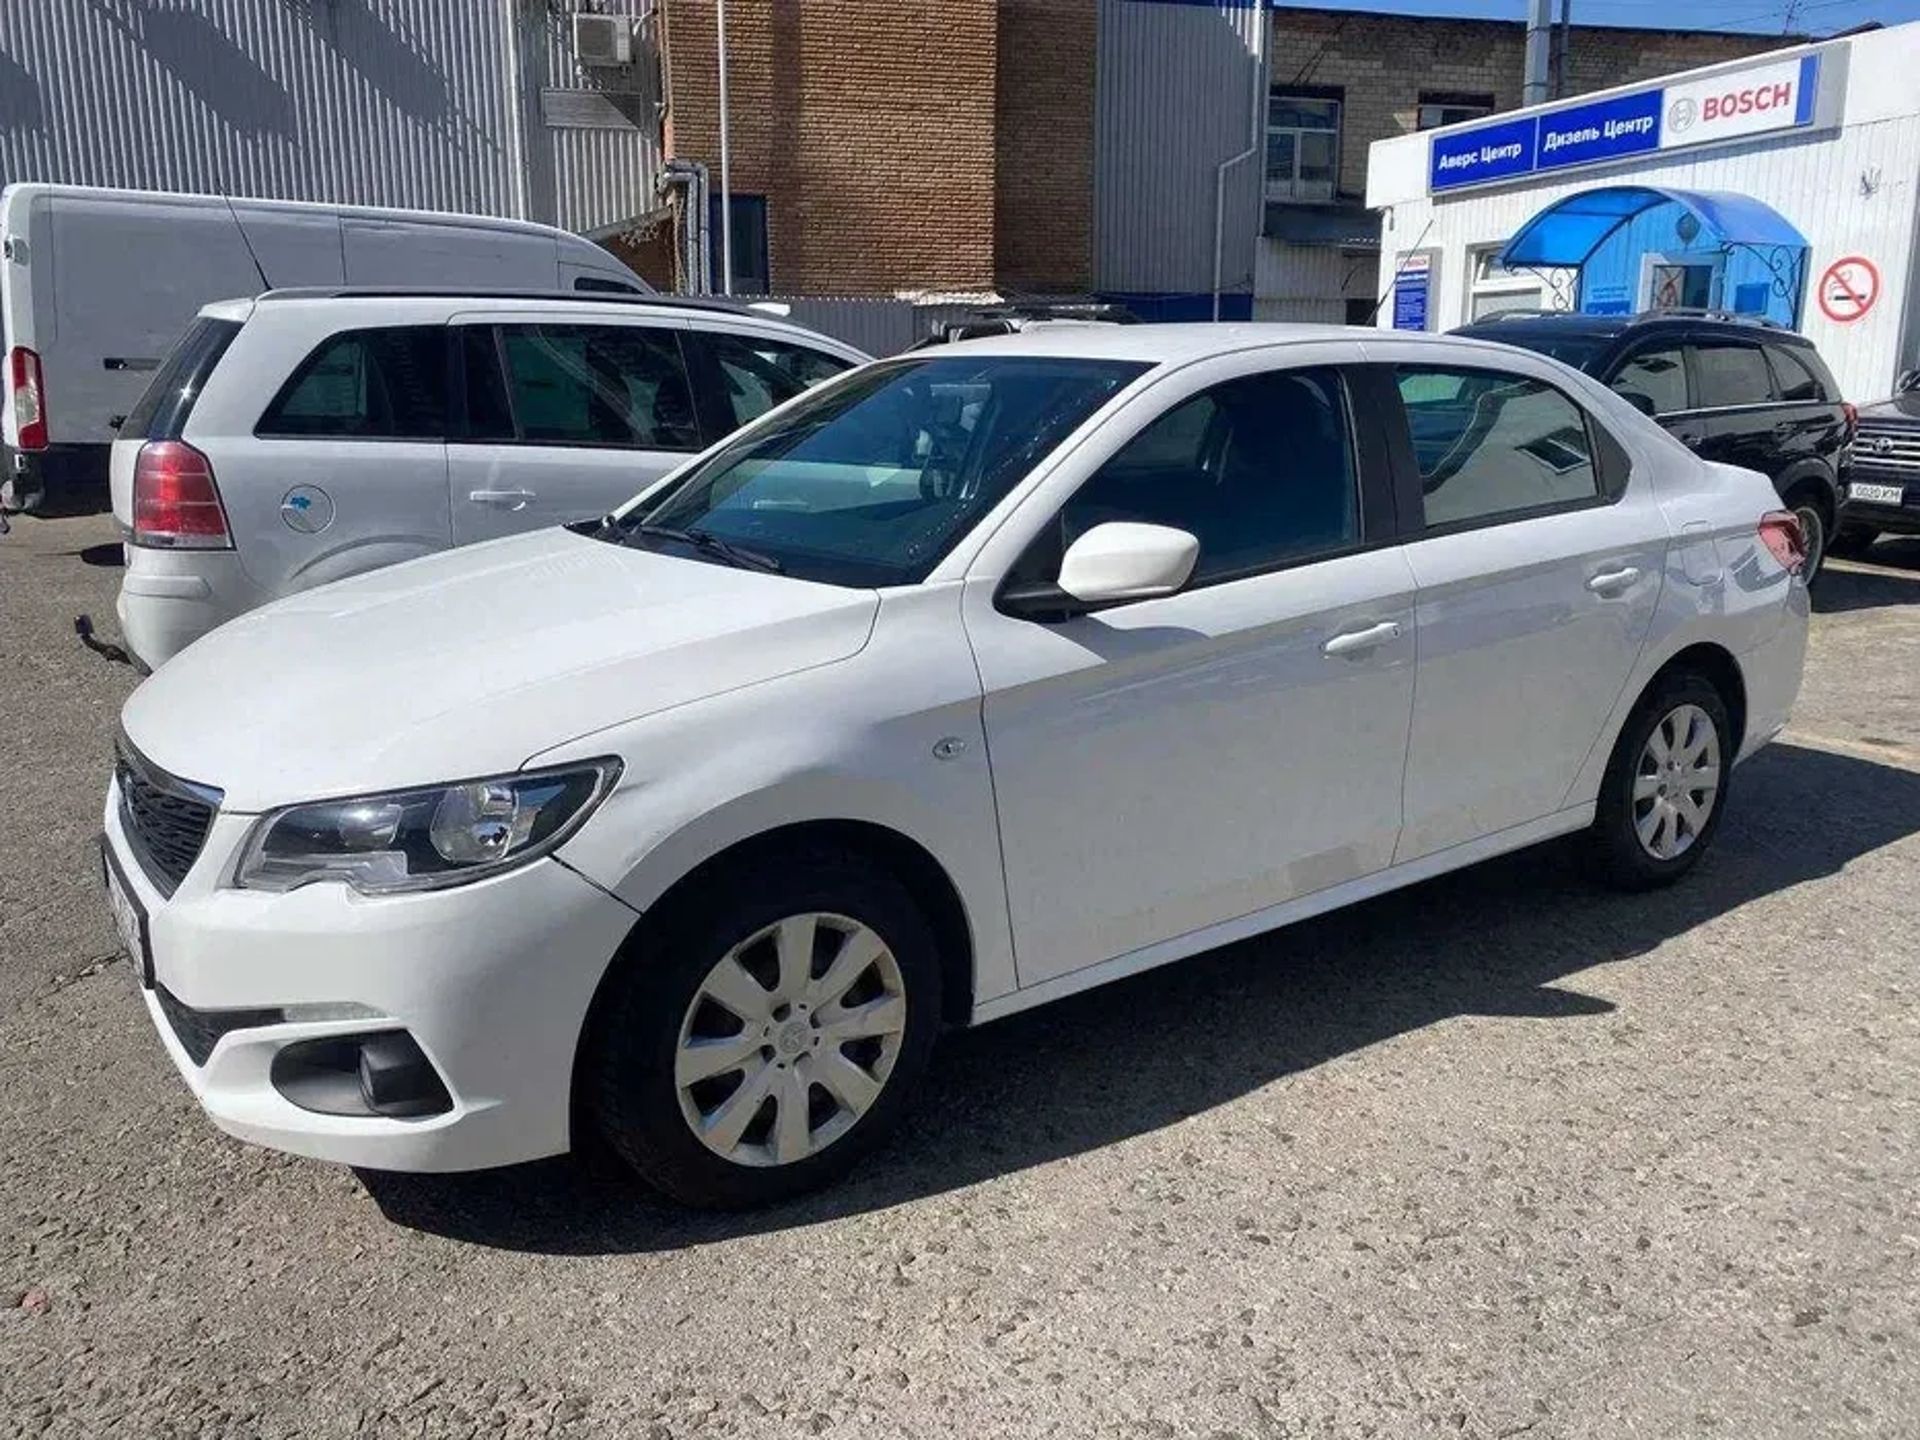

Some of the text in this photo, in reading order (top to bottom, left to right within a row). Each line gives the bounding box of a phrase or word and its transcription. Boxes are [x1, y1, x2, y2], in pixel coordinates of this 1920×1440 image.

[1703, 82, 1791, 121] BOSCH
[1543, 115, 1653, 152] Дизель Центр
[1438, 143, 1522, 171] Аверс Центр
